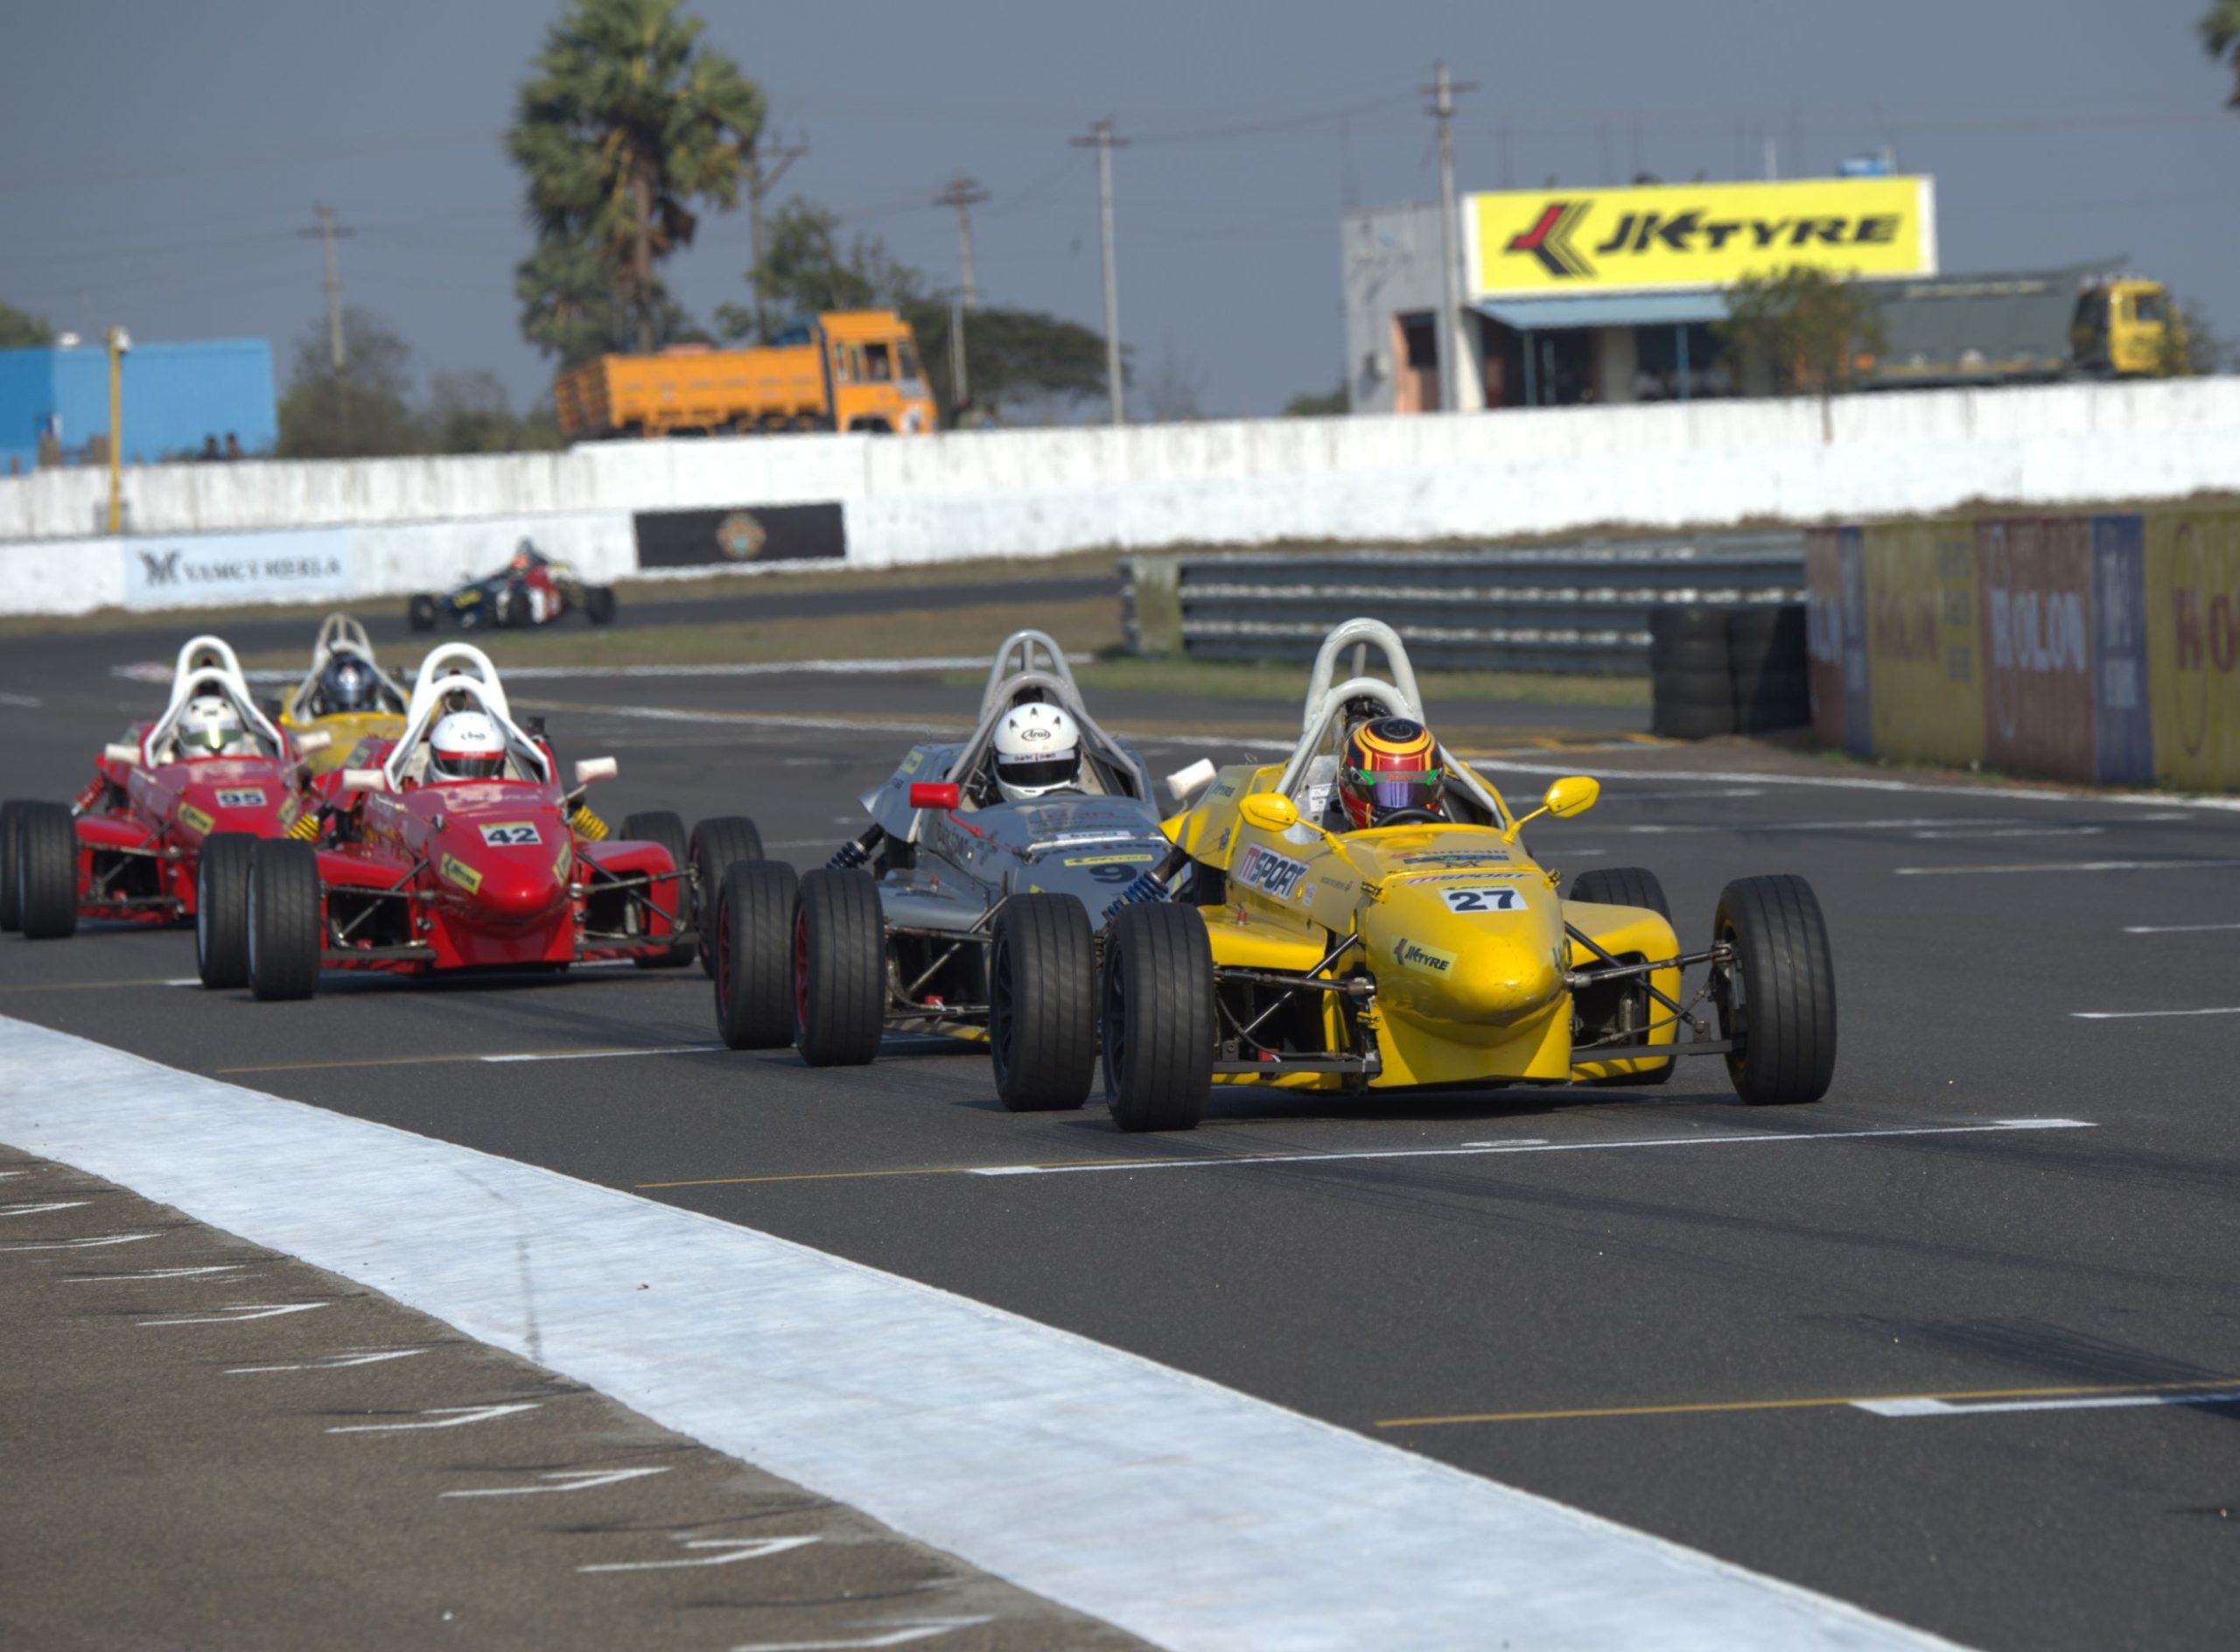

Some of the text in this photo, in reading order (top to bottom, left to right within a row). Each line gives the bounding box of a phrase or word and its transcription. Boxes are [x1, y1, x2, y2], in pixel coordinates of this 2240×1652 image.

[487, 828, 539, 844] 42
[1089, 864, 1138, 884] 9
[1449, 890, 1516, 911] 27
